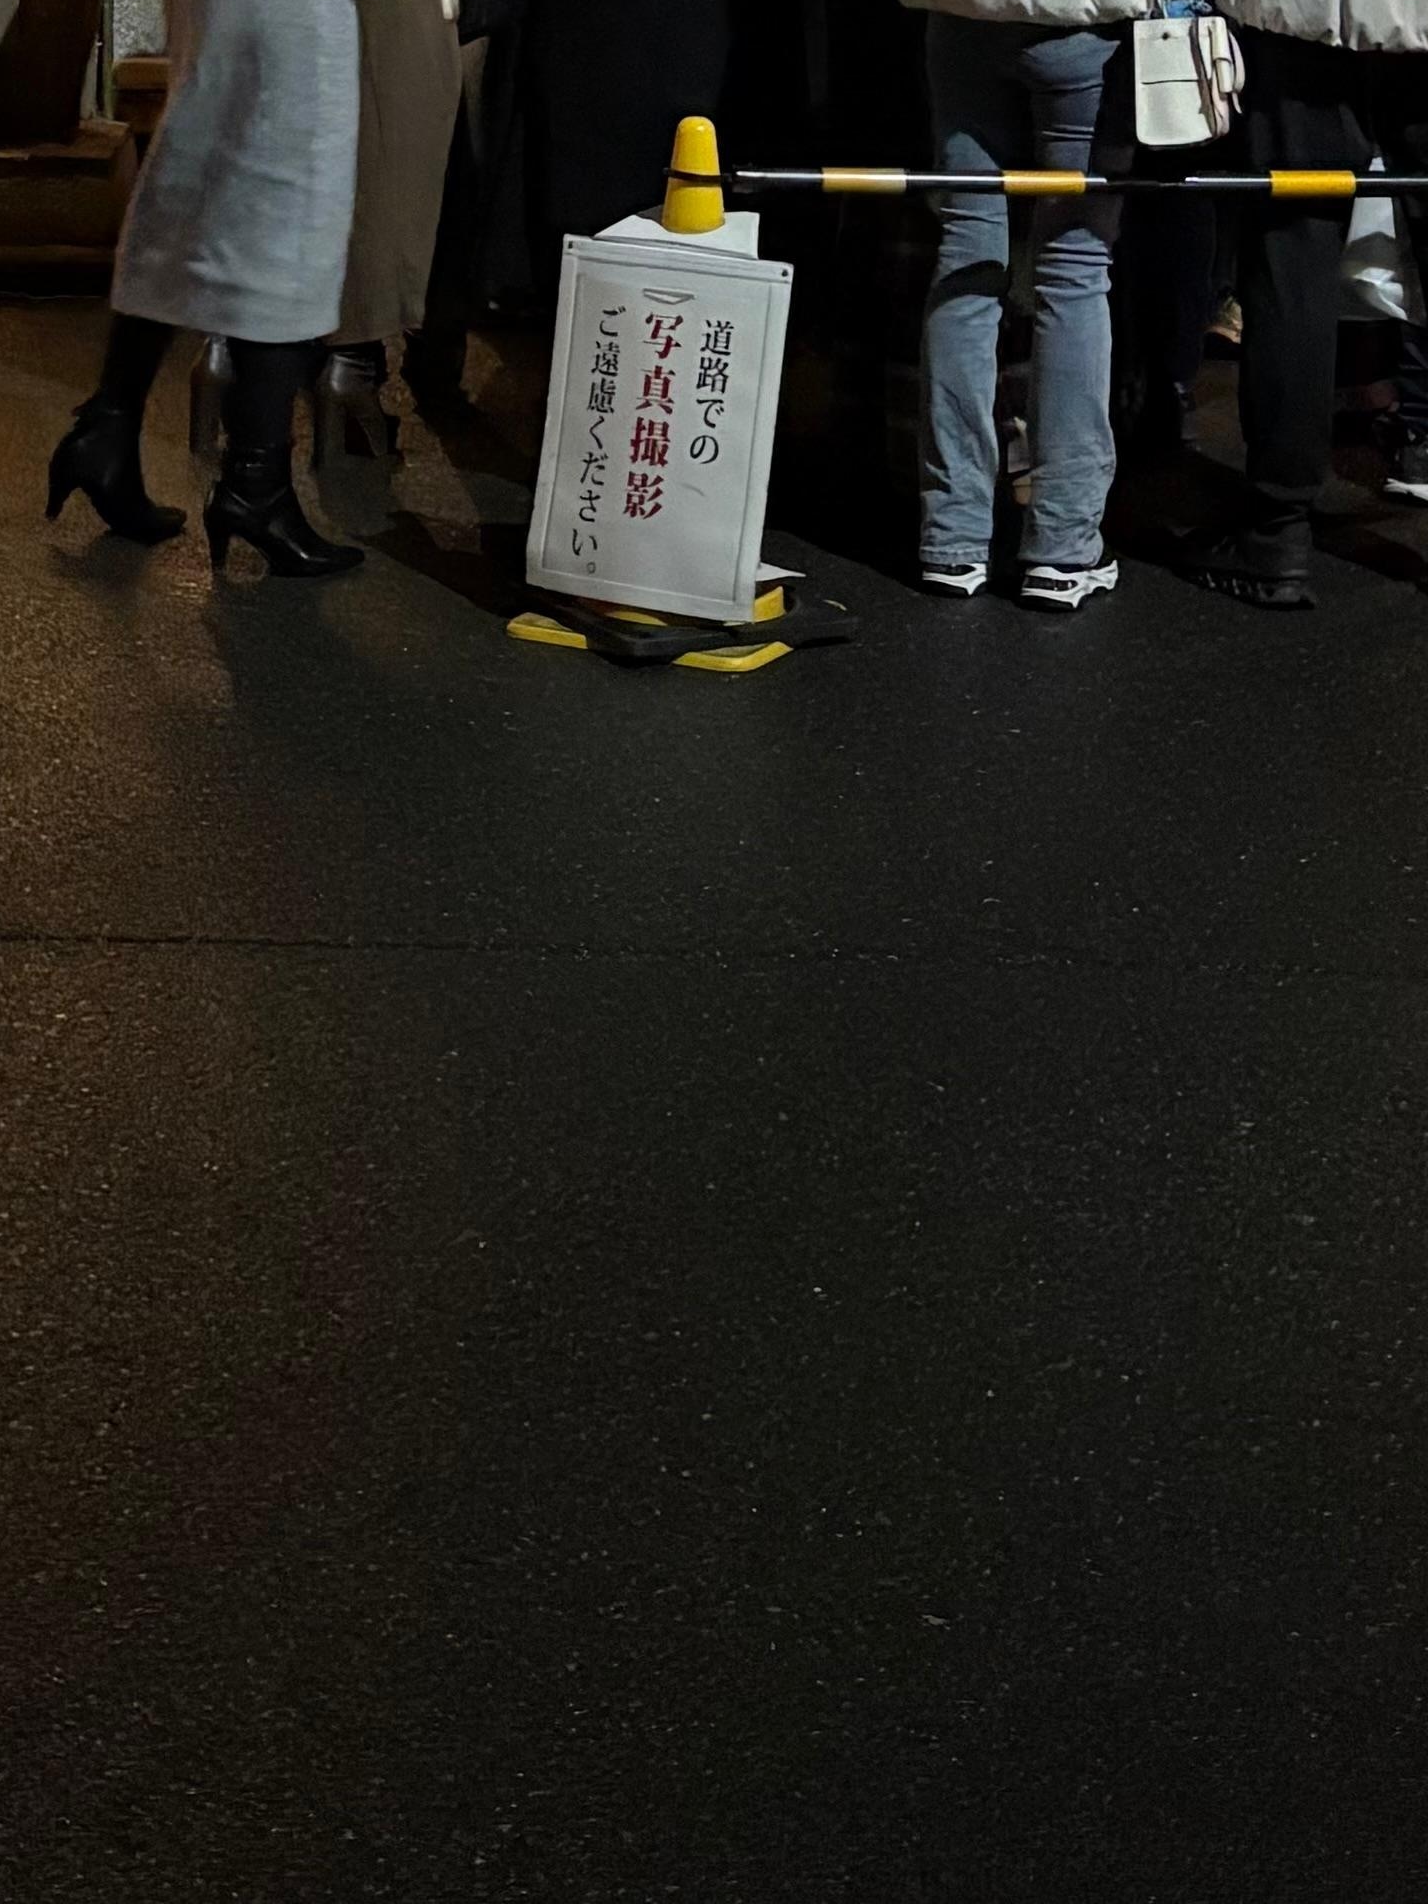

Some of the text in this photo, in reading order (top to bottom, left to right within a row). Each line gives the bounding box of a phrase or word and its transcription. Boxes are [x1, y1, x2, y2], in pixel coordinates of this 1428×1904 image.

[572, 307, 627, 575] ご遠慮ください。
[622, 312, 684, 520] 写真撮影
[689, 319, 735, 465] 道路での
